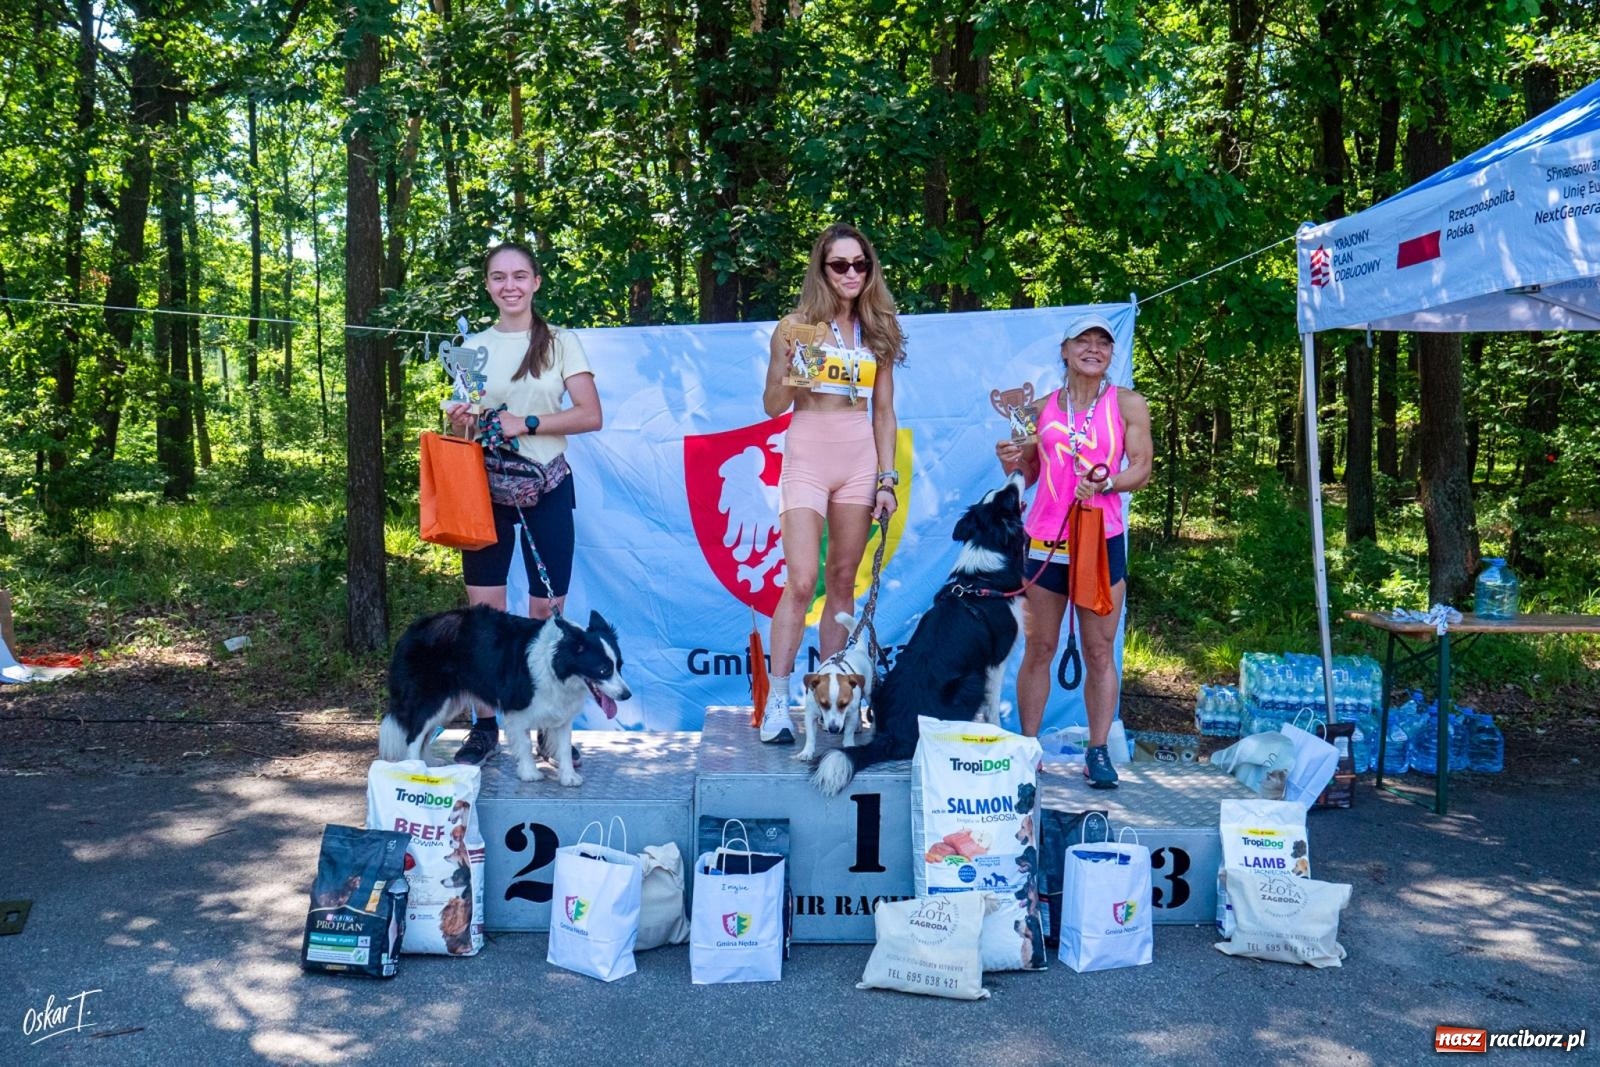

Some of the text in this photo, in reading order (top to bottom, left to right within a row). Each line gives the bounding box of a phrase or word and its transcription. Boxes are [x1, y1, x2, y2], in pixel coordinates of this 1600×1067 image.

[1563, 184, 1586, 199] Unię
[1448, 190, 1516, 223] Rzeczpospolita
[1334, 228, 1370, 250] KRAJOWY
[1446, 223, 1475, 240] Polska
[1333, 251, 1354, 267] PLAN
[1334, 258, 1382, 282] ODBUDOWY
[949, 757, 1010, 774] TropiDog
[396, 788, 453, 808] TropiDog
[946, 795, 1013, 815] SALMON
[393, 817, 445, 841] BEEF
[848, 793, 887, 873] 1
[1241, 837, 1284, 850] TropiDog
[504, 822, 560, 903] 2
[1243, 856, 1286, 869] LAMB
[1150, 847, 1191, 909] 3
[316, 920, 364, 932] PRO PLAN
[906, 971, 922, 984] 695
[924, 975, 941, 987] 638
[943, 977, 959, 989] 421
